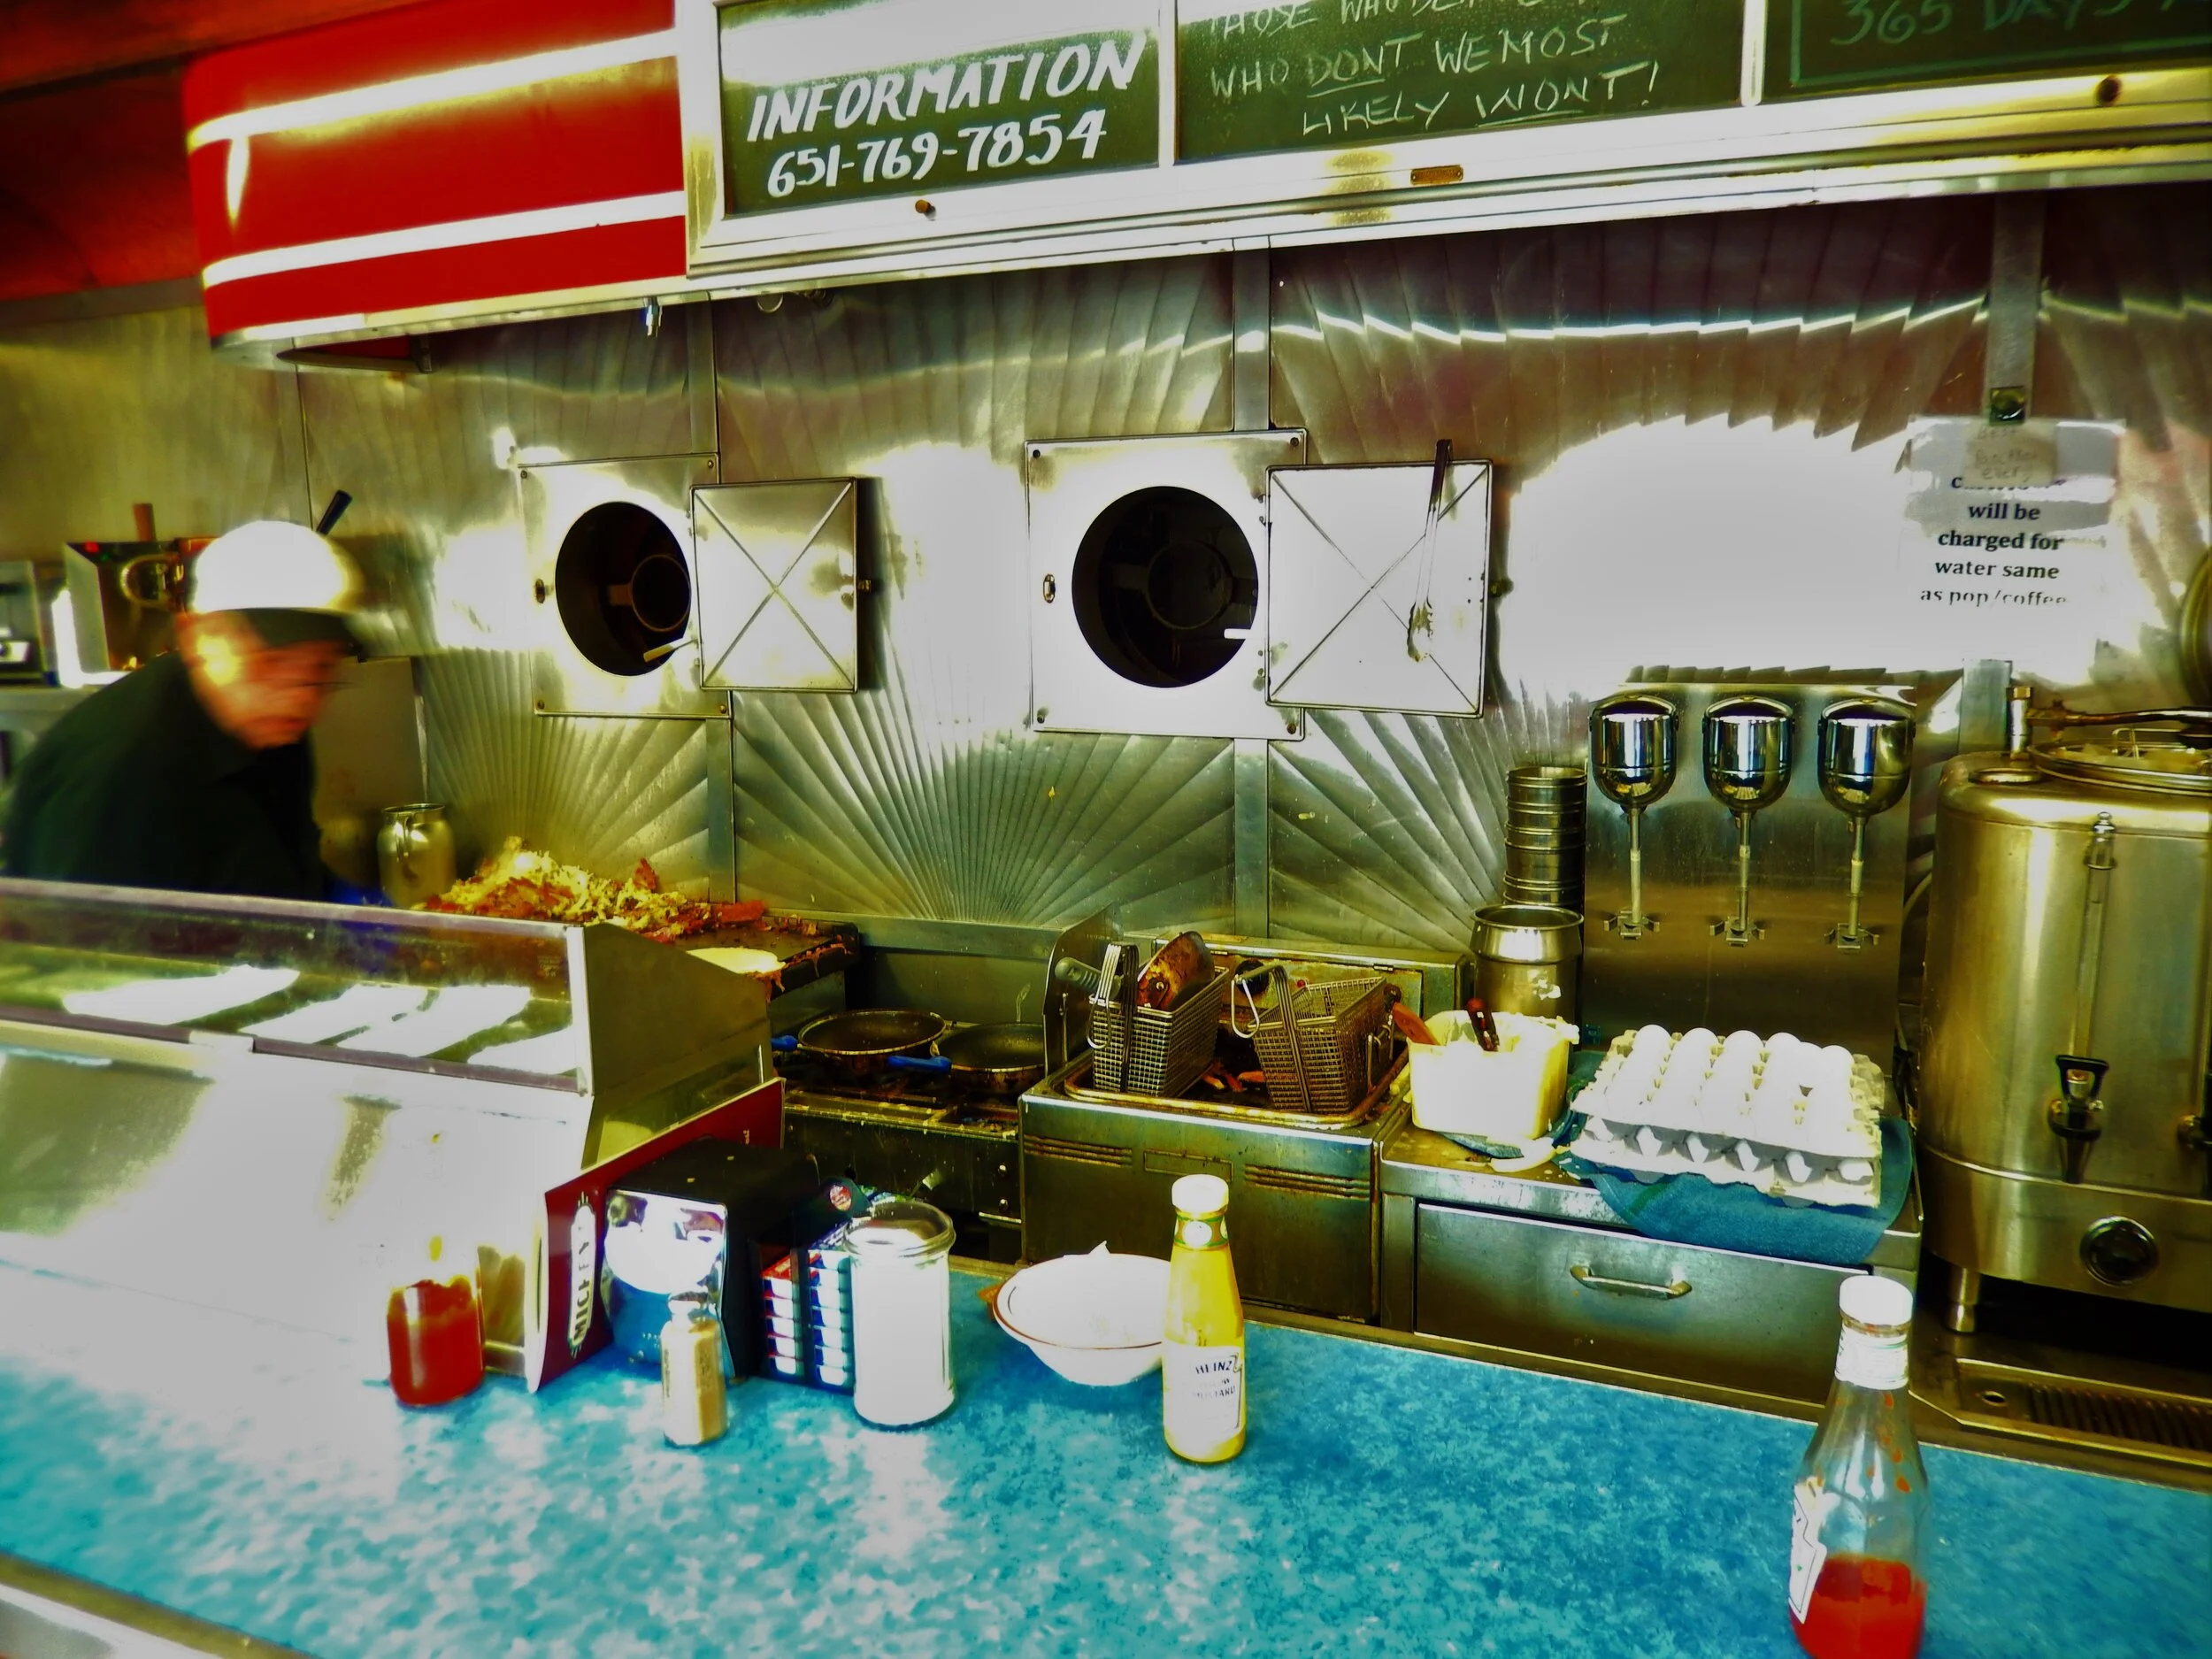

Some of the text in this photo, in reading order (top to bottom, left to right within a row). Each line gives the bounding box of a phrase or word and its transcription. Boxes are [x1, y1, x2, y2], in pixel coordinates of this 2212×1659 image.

[1829, 0, 1953, 46] 365
[1210, 58, 1290, 98] WHO
[1435, 32, 1491, 74] WE
[1501, 13, 1627, 65] MOST
[746, 30, 1148, 142] INFORMATION
[1302, 90, 1450, 135] LIKELY
[766, 108, 1108, 198] 651-769-7854
[1968, 503, 2041, 520] will be
[1938, 530, 2064, 552] charged for
[1934, 561, 2060, 580] water same
[1920, 589, 1943, 602] as
